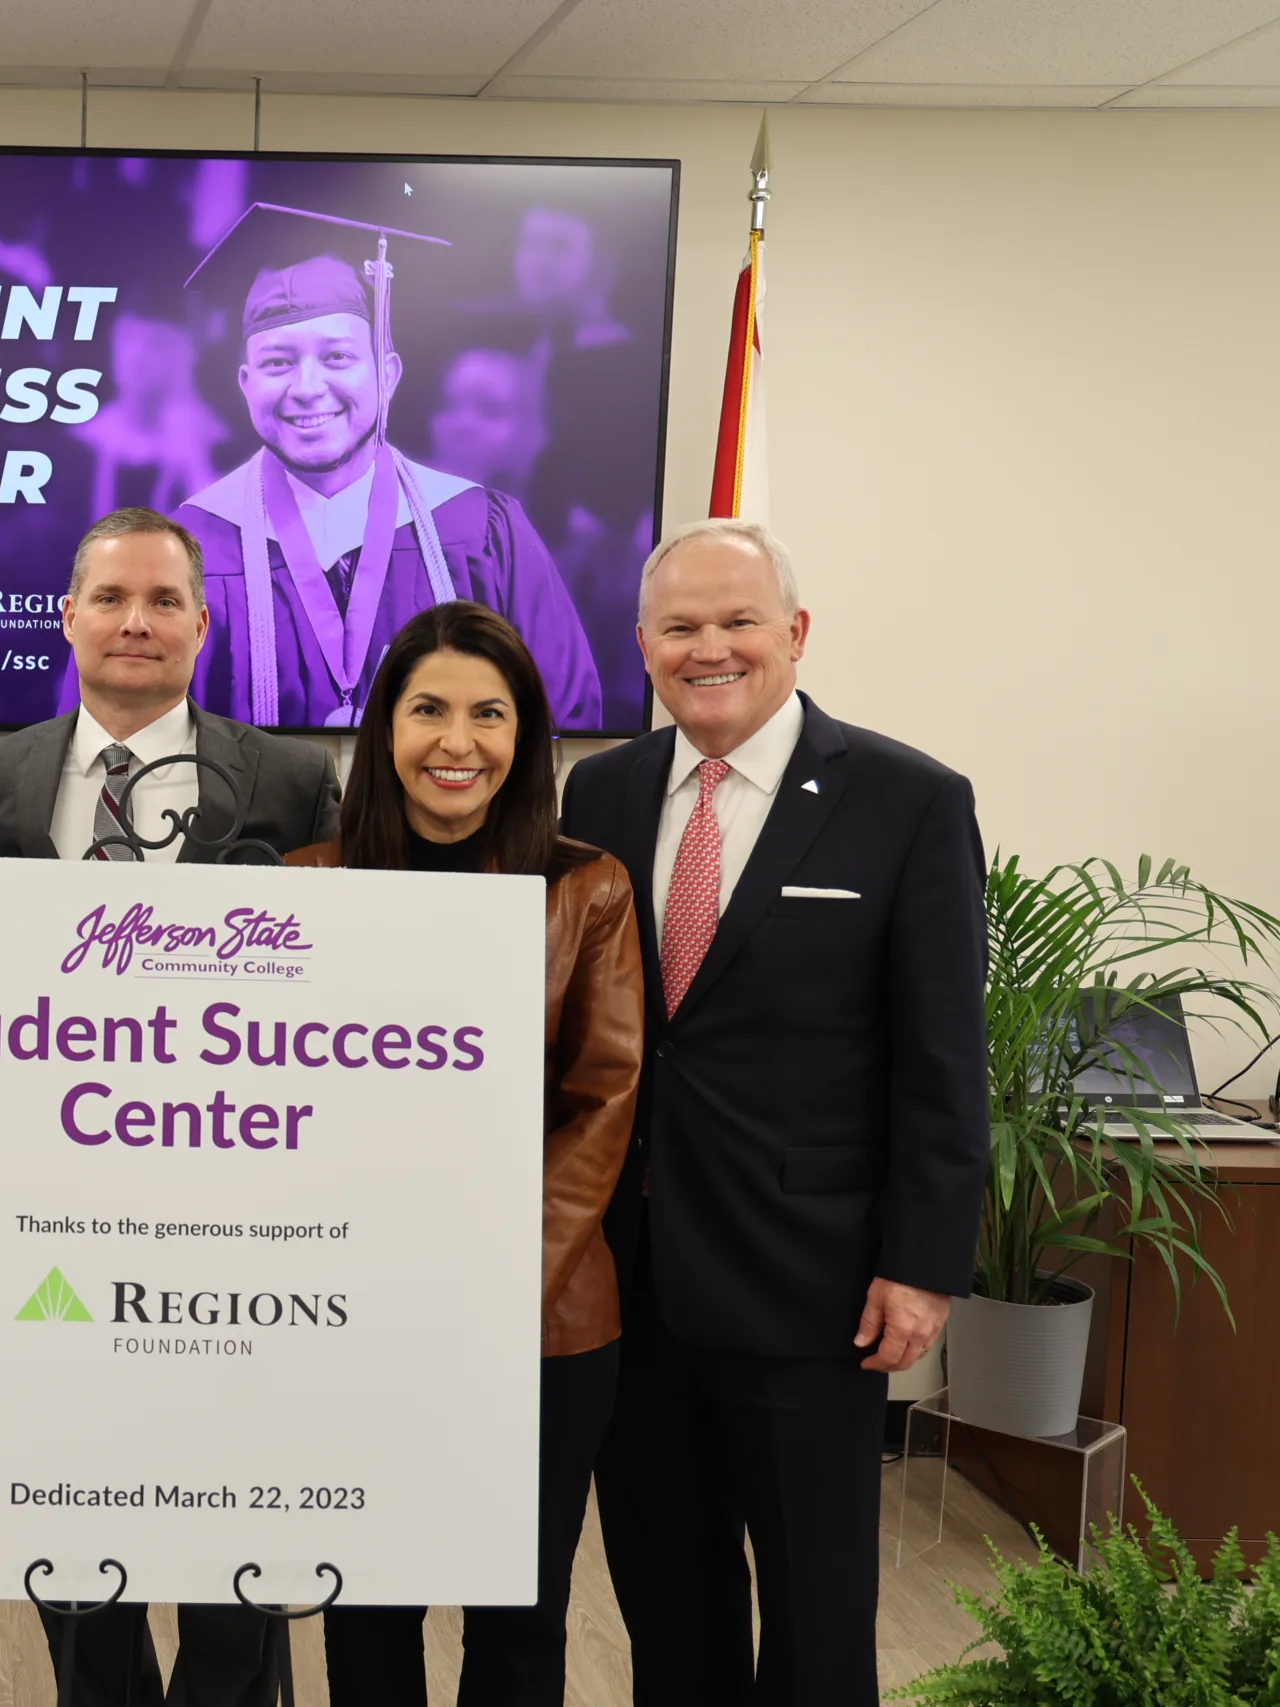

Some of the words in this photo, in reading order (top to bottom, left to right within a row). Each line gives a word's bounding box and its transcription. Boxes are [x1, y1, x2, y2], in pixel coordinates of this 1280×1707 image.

[60, 902, 216, 976] Jefferson
[216, 907, 313, 960] State
[141, 958, 239, 977] Community
[243, 961, 304, 978] College
[199, 1002, 485, 1072] Success
[60, 1081, 314, 1150] Center
[15, 1215, 86, 1234] Thanks
[91, 1218, 112, 1235] to
[117, 1217, 149, 1236] the
[154, 1222, 244, 1240] generous
[249, 1222, 324, 1242] support
[329, 1221, 349, 1239] of
[110, 1281, 348, 1328] REGIONS
[113, 1338, 254, 1356] FOUNDATION
[10, 1482, 145, 1508] Dedicated
[155, 1484, 237, 1509] March
[248, 1486, 290, 1513] 22,
[298, 1486, 365, 1510] 2023
